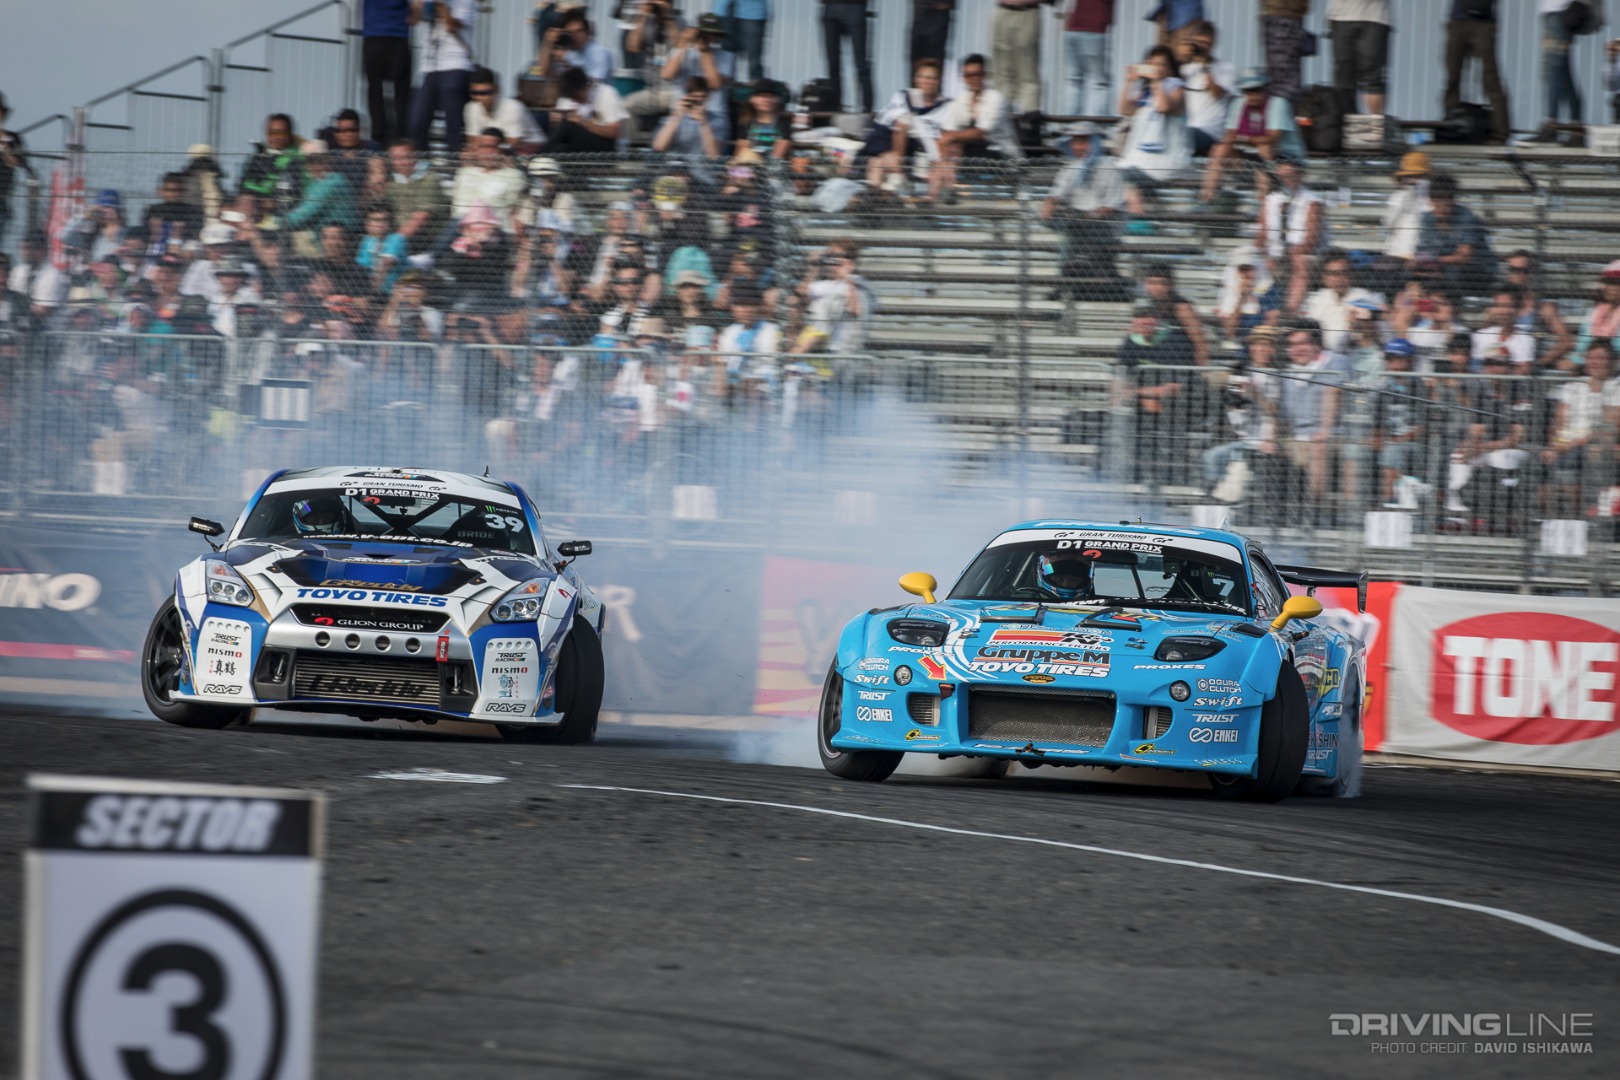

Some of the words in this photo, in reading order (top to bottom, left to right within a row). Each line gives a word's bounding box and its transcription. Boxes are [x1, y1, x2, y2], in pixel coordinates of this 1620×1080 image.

[345, 488, 367, 497] D1
[369, 488, 411, 496] GRAND
[411, 491, 440, 499] PRIX
[484, 513, 524, 533] 39
[457, 530, 495, 539] BRIDE
[1107, 533, 1147, 541] TURISMO
[1056, 540, 1083, 550] D1
[1084, 540, 1129, 549] GRAND
[1131, 543, 1164, 553] PRIX
[1212, 578, 1235, 597] 7
[297, 588, 367, 601] TOYO
[371, 591, 448, 608] TIRES
[379, 622, 424, 630] GROUP
[988, 640, 1066, 648] PERFORMANCE
[1068, 643, 1109, 651] FILTERS
[208, 647, 242, 658] nismo
[978, 646, 1111, 664] GruppeM
[969, 661, 1035, 674] TOYO
[1034, 664, 1111, 678] TIRES
[855, 675, 890, 685] Swift
[1208, 678, 1240, 687] OGURA
[1443, 635, 1617, 722] TONE
[203, 684, 242, 694] RAYS
[1209, 685, 1241, 693] CLUTCH
[858, 691, 891, 700] TRUST
[1193, 696, 1243, 707] Swift
[485, 703, 526, 713] RAYS
[872, 709, 893, 721] ENKEI
[1192, 714, 1239, 722] TRUST
[1214, 729, 1238, 742] ENKEI
[75, 795, 282, 850] SECTOR
[115, 939, 234, 1080] 3
